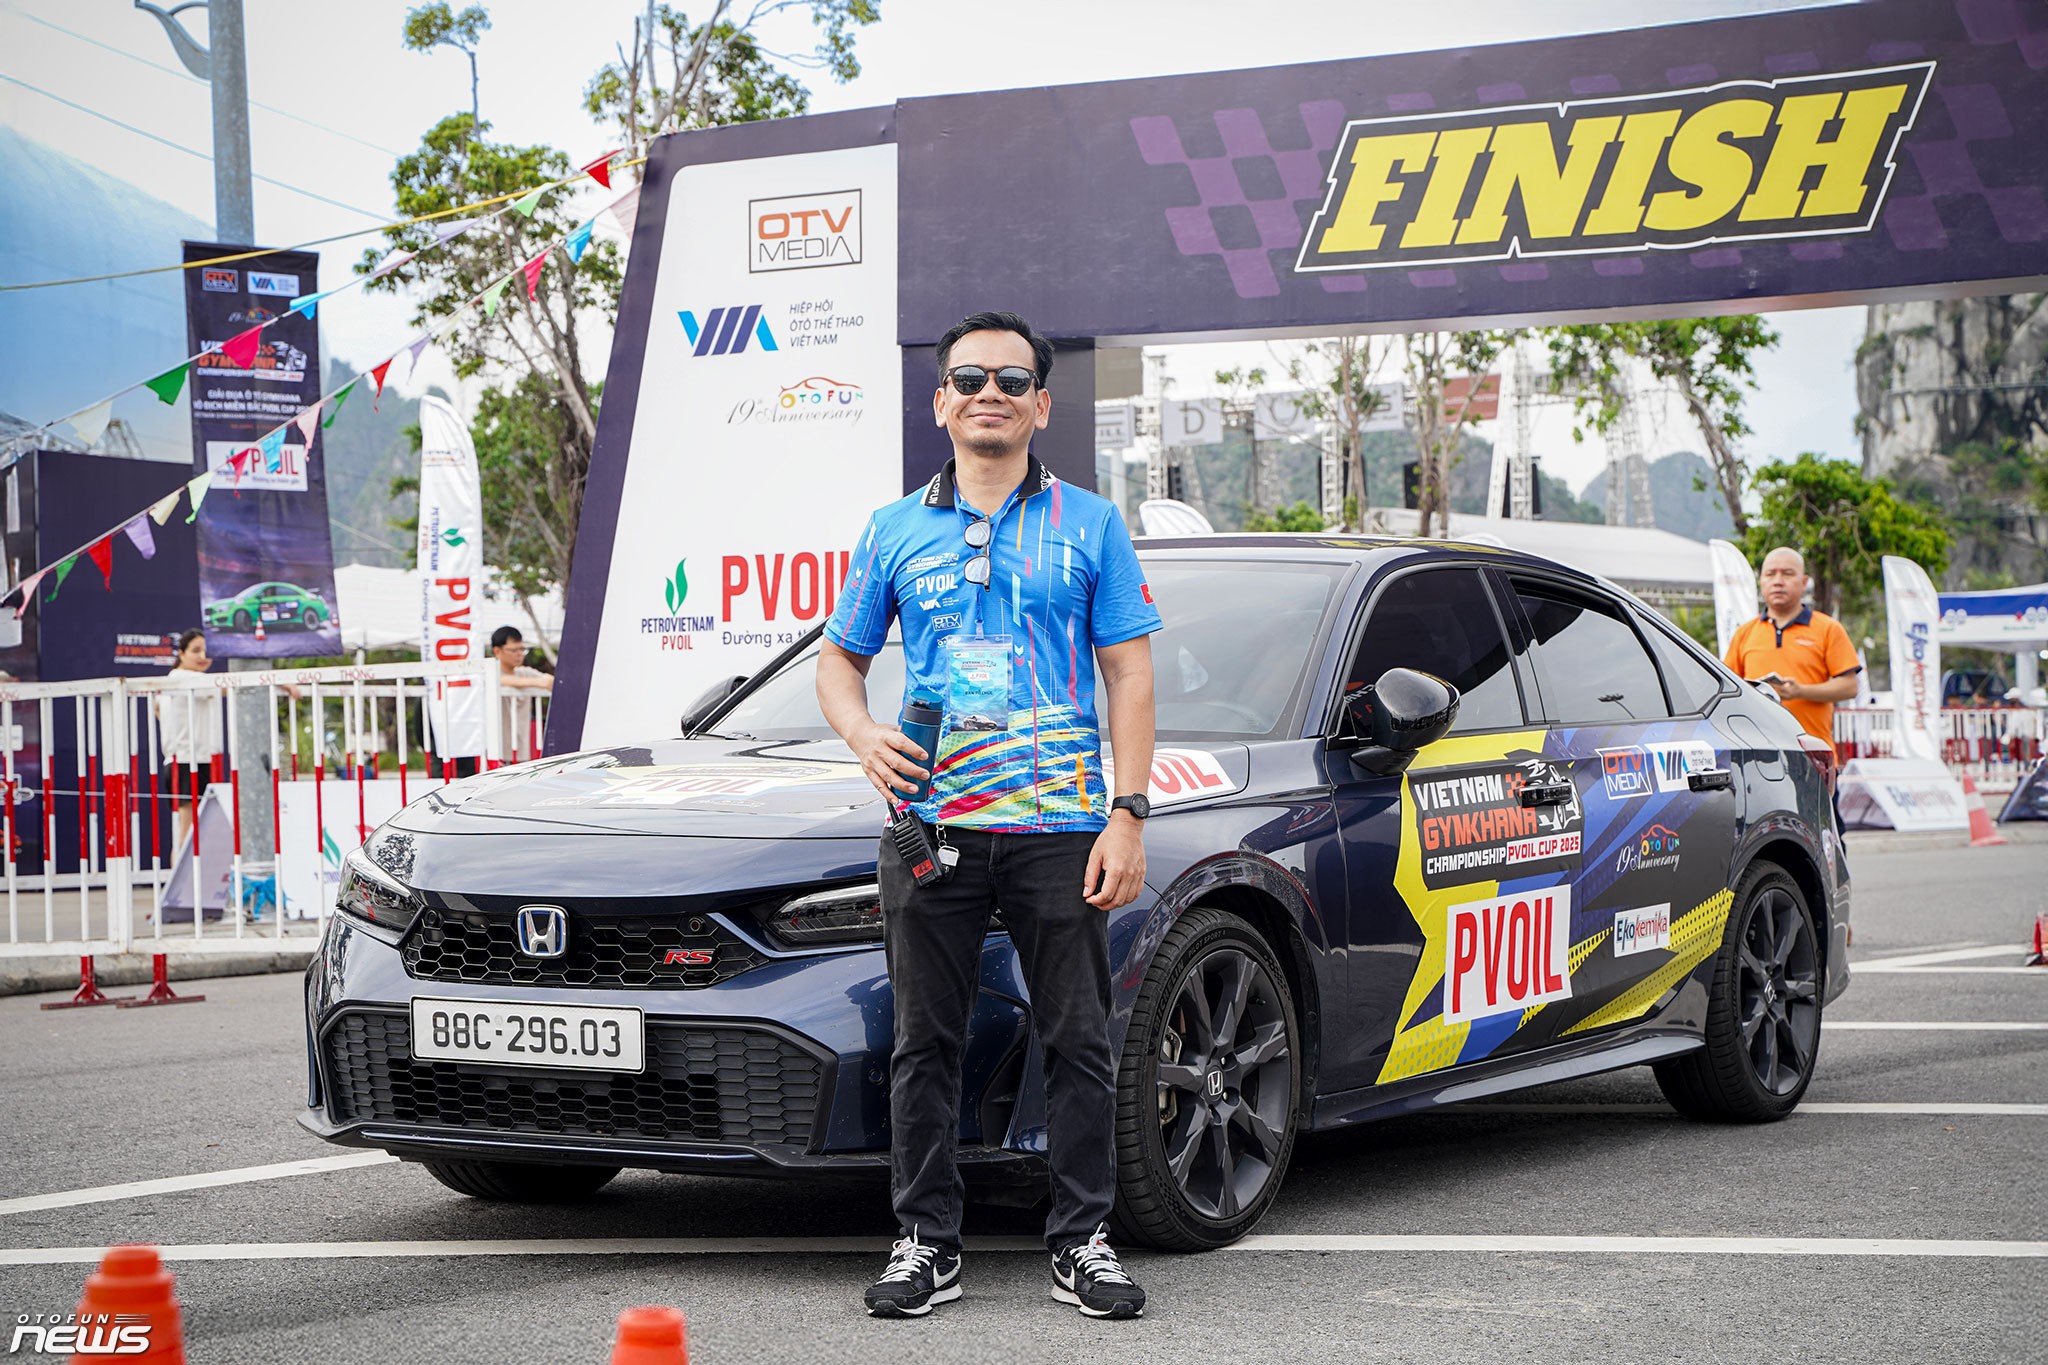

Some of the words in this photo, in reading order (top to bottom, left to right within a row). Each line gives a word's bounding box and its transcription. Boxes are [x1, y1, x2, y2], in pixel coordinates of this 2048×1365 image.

[1318, 83, 1908, 254] FINISH
[758, 206, 853, 240] OTV
[758, 236, 856, 263] MEDIA
[836, 314, 864, 328] THAO
[813, 332, 838, 346] NAM
[780, 389, 863, 409] OTOFUN
[755, 403, 864, 427] Anniversary
[916, 573, 958, 596] PVOIL
[641, 615, 715, 634] PETROVIETNAM
[934, 614, 959, 624] OTV
[662, 635, 693, 651] PVOIL
[722, 630, 772, 648] Đường
[777, 632, 794, 643] xa
[1604, 750, 1642, 775] OTV
[607, 778, 764, 794] PVOIL
[1415, 774, 1504, 811] VIETNAM
[1607, 771, 1652, 793] MEDIA
[1423, 806, 1538, 850] GYMKHANA
[1426, 847, 1506, 875] CHAMPIONSHIP
[1508, 843, 1536, 861] PVOIL
[1538, 839, 1558, 856] CUP
[1560, 836, 1579, 853] 2025
[1640, 836, 1680, 856] OTOFUN
[1630, 849, 1680, 872] Anniversary
[1616, 909, 1668, 953] Ekokemika
[662, 949, 715, 965] RS
[1451, 896, 1564, 1014] PVOIL
[1153, 960, 1185, 1031] MICHELIN
